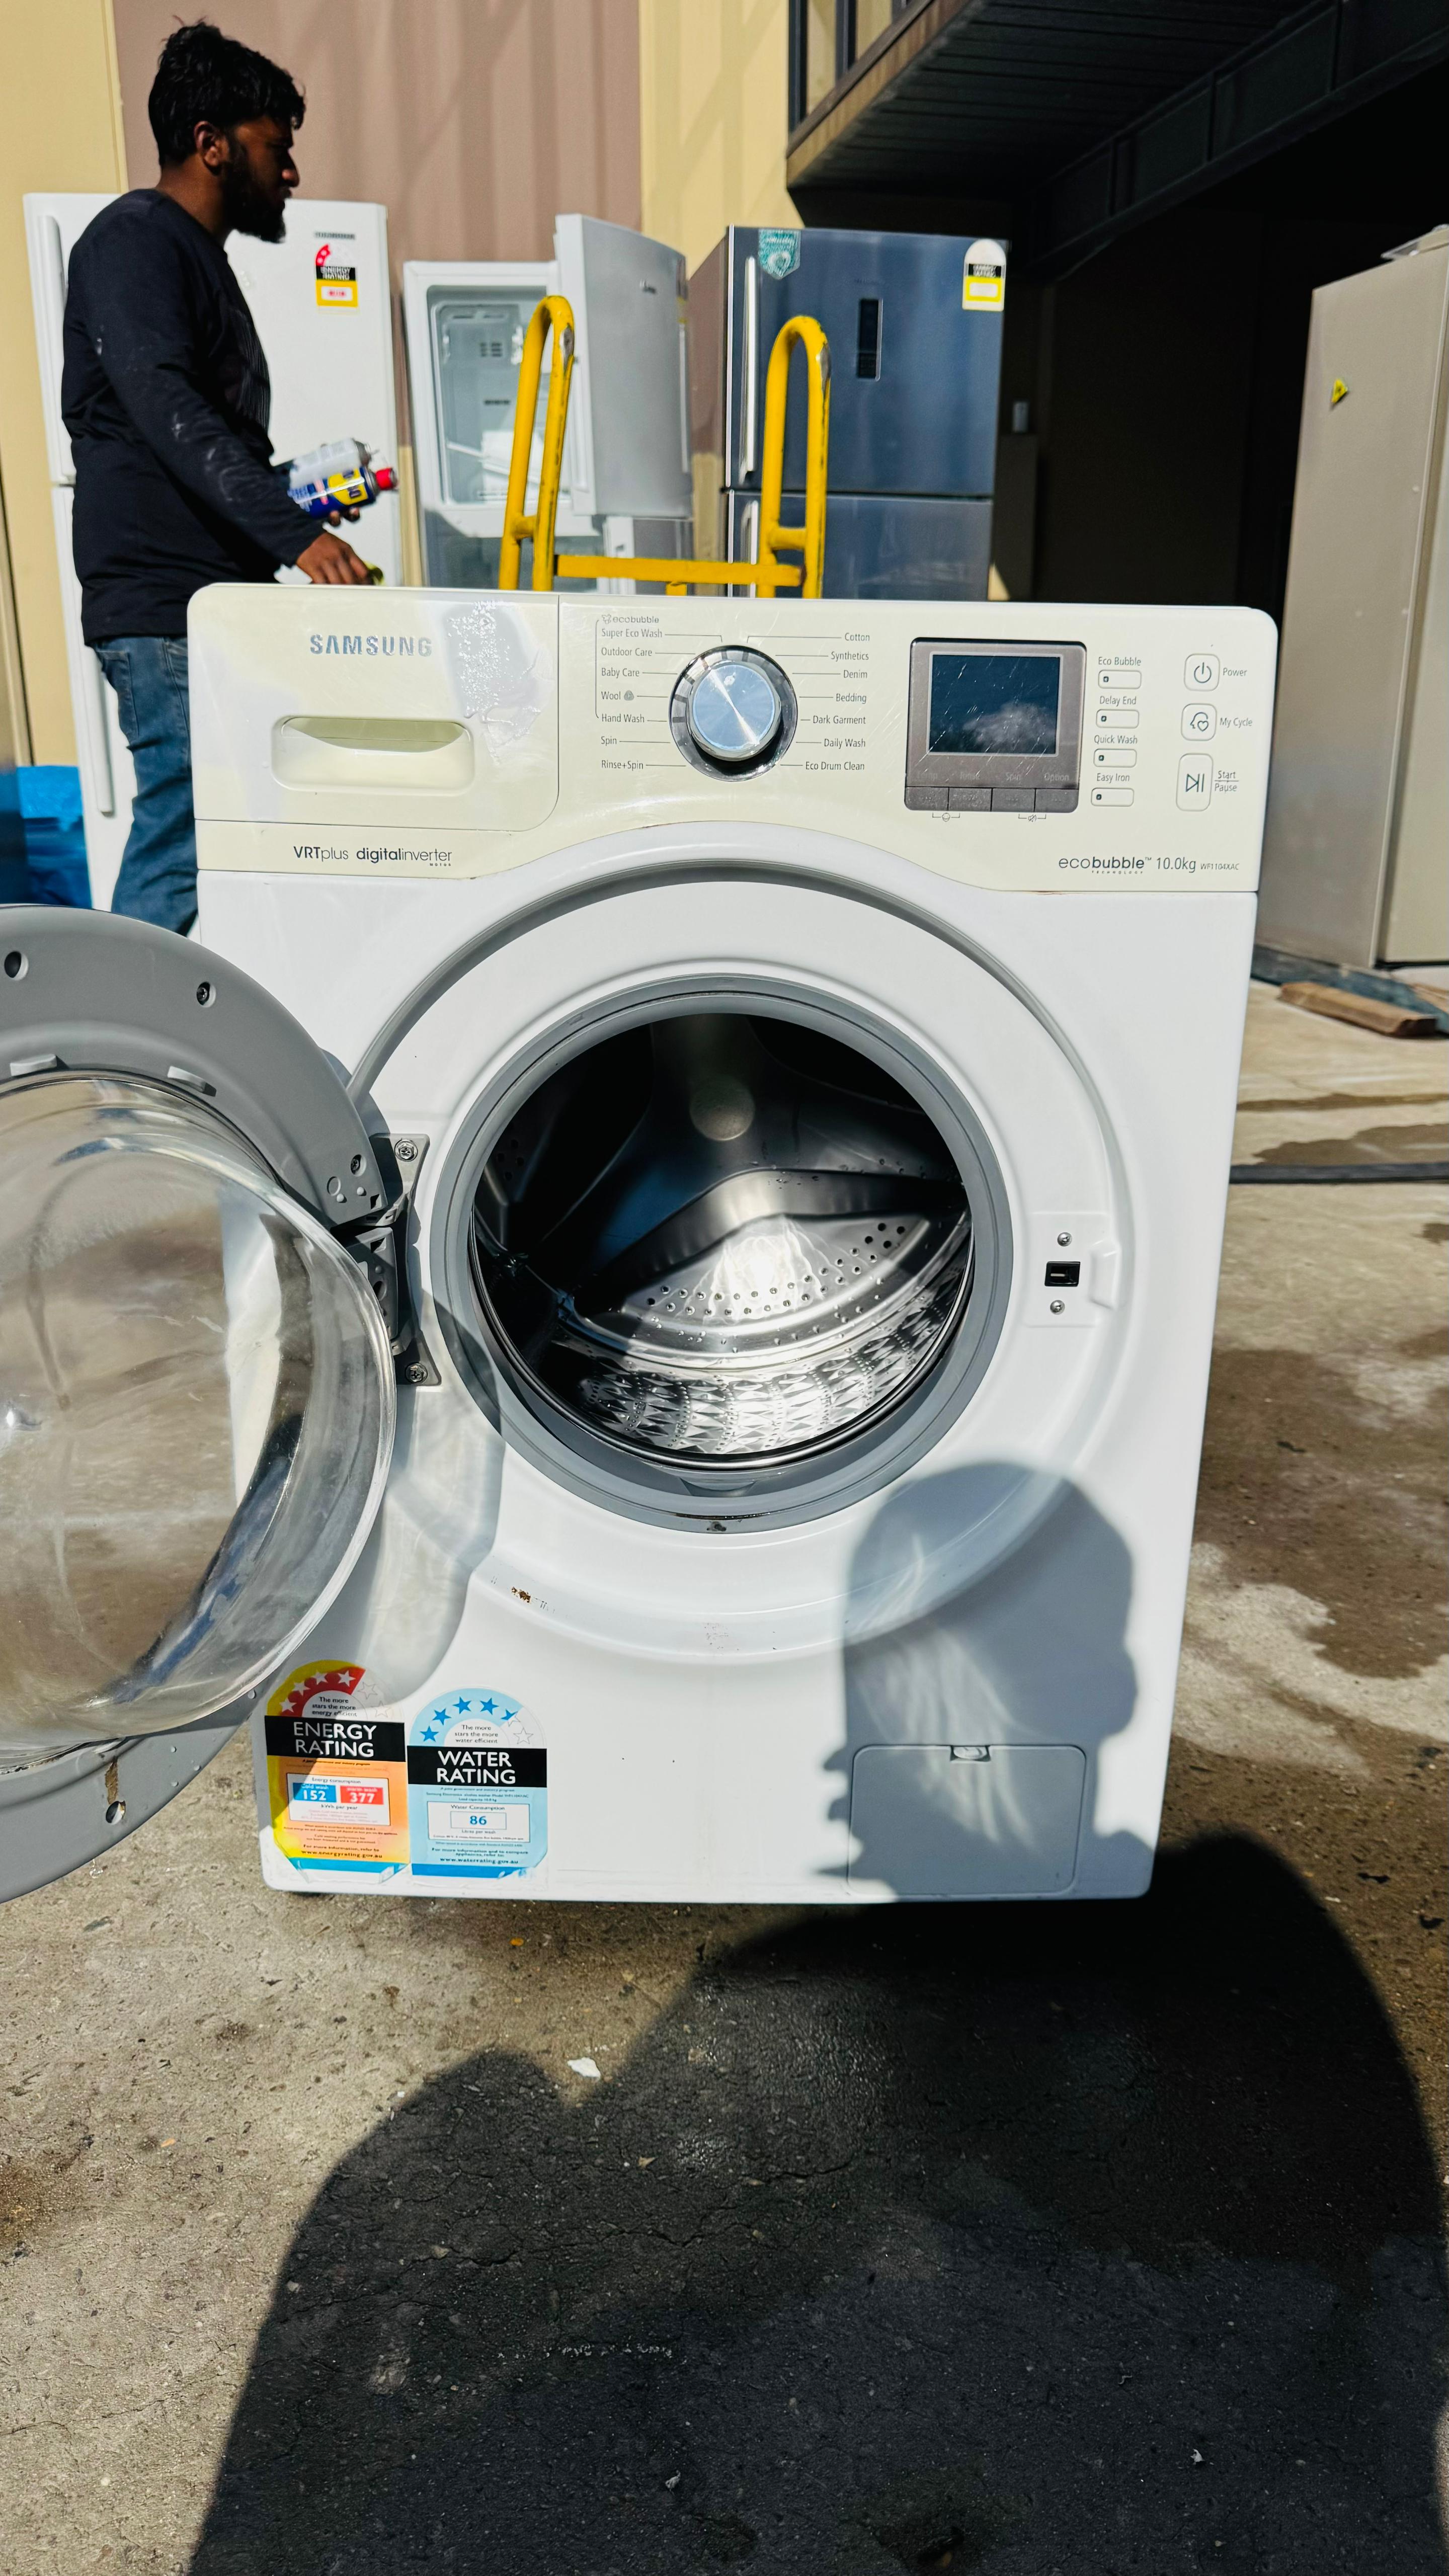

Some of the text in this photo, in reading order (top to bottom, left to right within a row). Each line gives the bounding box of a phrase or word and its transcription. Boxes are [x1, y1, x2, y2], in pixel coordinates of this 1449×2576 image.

[602, 628, 662, 639] Super Eco Wash
[845, 632, 870, 641] Cotton
[310, 634, 432, 657] SAMSUNG
[601, 647, 653, 656] Outdoor Care
[831, 651, 869, 662] Synthetics
[1098, 657, 1141, 666] Eco Bubble
[601, 667, 639, 679] Baby Care
[843, 670, 867, 678] Denim
[1223, 667, 1247, 676] Power
[601, 691, 621, 700] Wool
[836, 693, 867, 704] Bedding
[1100, 695, 1137, 707] Delay End
[602, 713, 645, 722] Hand Wash
[813, 714, 866, 724] Dark Garment
[1220, 717, 1253, 728] My Cycle
[601, 736, 617, 746] Spin
[824, 738, 866, 749] Daily Wash
[1094, 735, 1138, 744] Quick Wash
[601, 760, 643, 771] Rinse+Spin
[806, 761, 865, 770] Eco Drum Clean
[1044, 772, 1069, 781] Option
[1097, 773, 1130, 783] Easy Iron
[1218, 770, 1236, 779] Start
[1215, 783, 1237, 792] Pause
[293, 846, 452, 863] VRTplus digitalinverter
[1156, 857, 1196, 873] 10.0kg
[293, 1722, 377, 1740] ENERGY
[296, 1739, 374, 1757] RATING
[438, 1750, 512, 1767] WATER
[437, 1768, 516, 1784] RATING
[303, 1790, 327, 1801] 152
[350, 1792, 375, 1803] 377
[469, 1815, 487, 1825] 86
